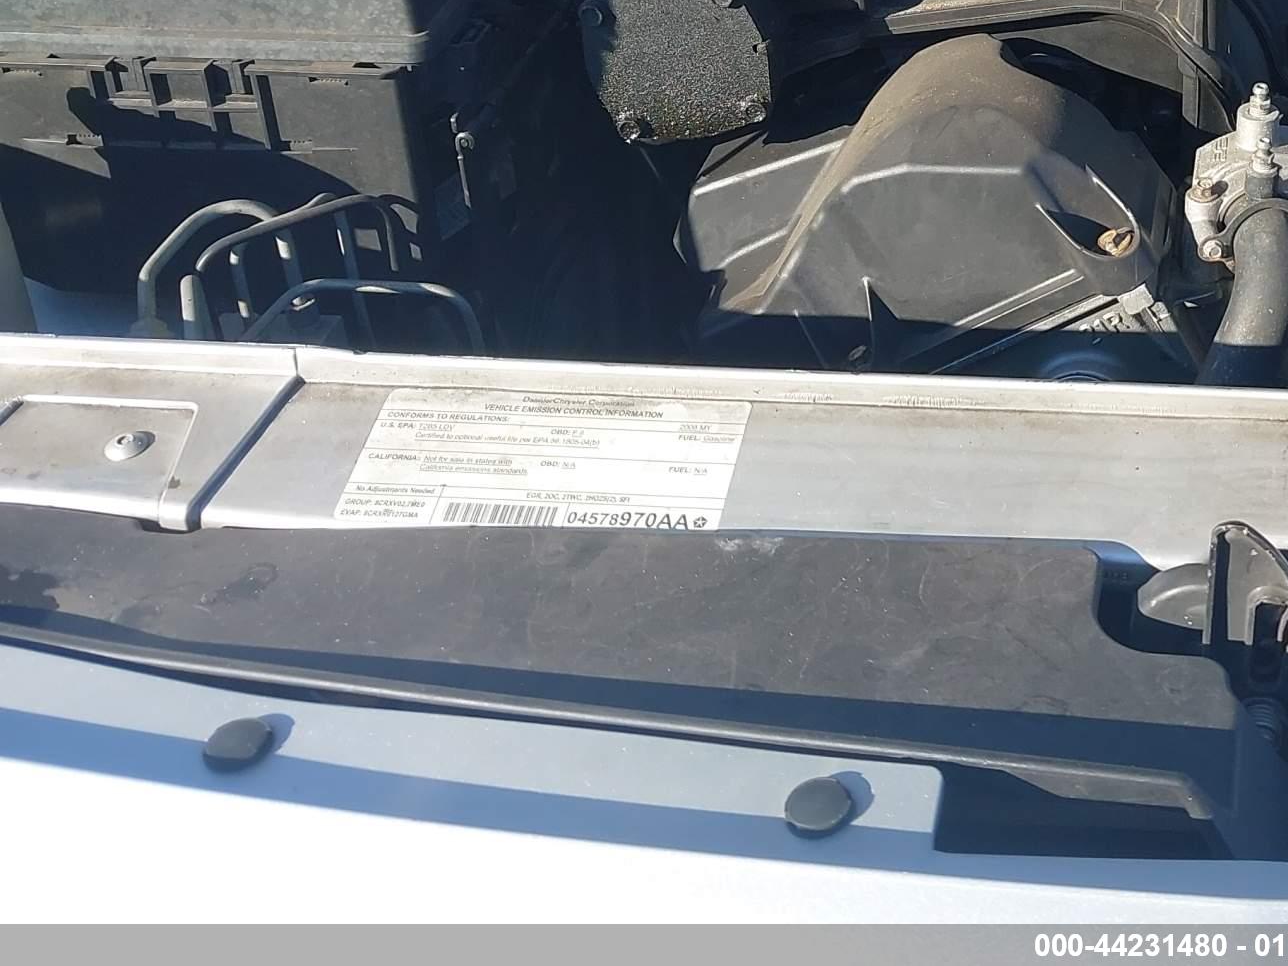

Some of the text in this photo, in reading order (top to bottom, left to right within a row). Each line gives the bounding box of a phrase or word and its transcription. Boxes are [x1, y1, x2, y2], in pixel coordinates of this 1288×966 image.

[388, 411, 435, 419] CONFORMS
[450, 414, 510, 422] REGULATIONS:
[522, 405, 562, 413] EMISSION
[605, 409, 663, 418] INFORMATION
[566, 511, 689, 530] 04578970AA
